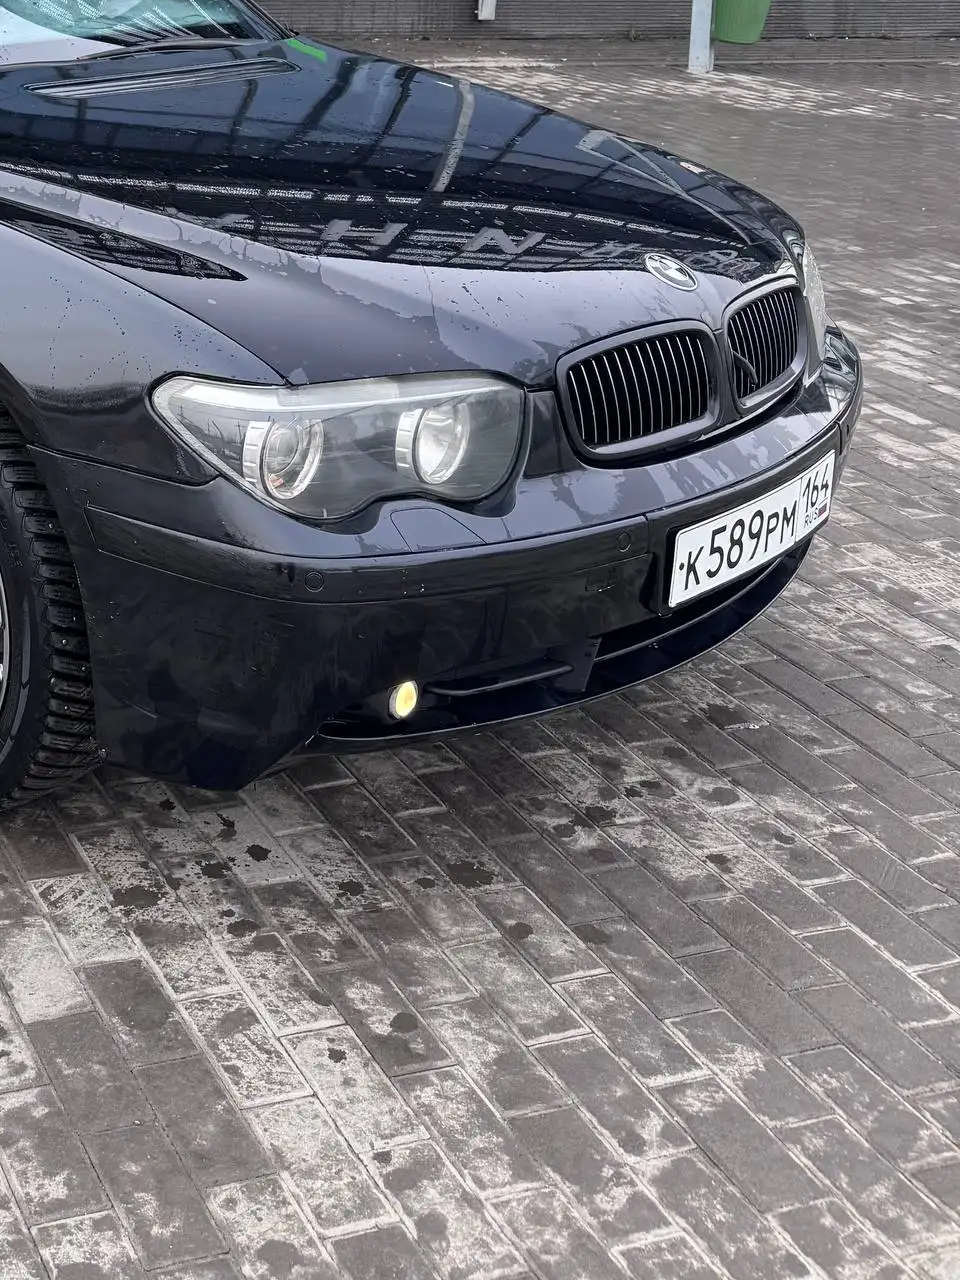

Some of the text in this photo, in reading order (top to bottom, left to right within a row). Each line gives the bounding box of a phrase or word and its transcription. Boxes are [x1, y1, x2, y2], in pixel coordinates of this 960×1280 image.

[802, 463, 830, 514] 164
[804, 506, 819, 529] RUS
[684, 500, 798, 591] К589РМ
